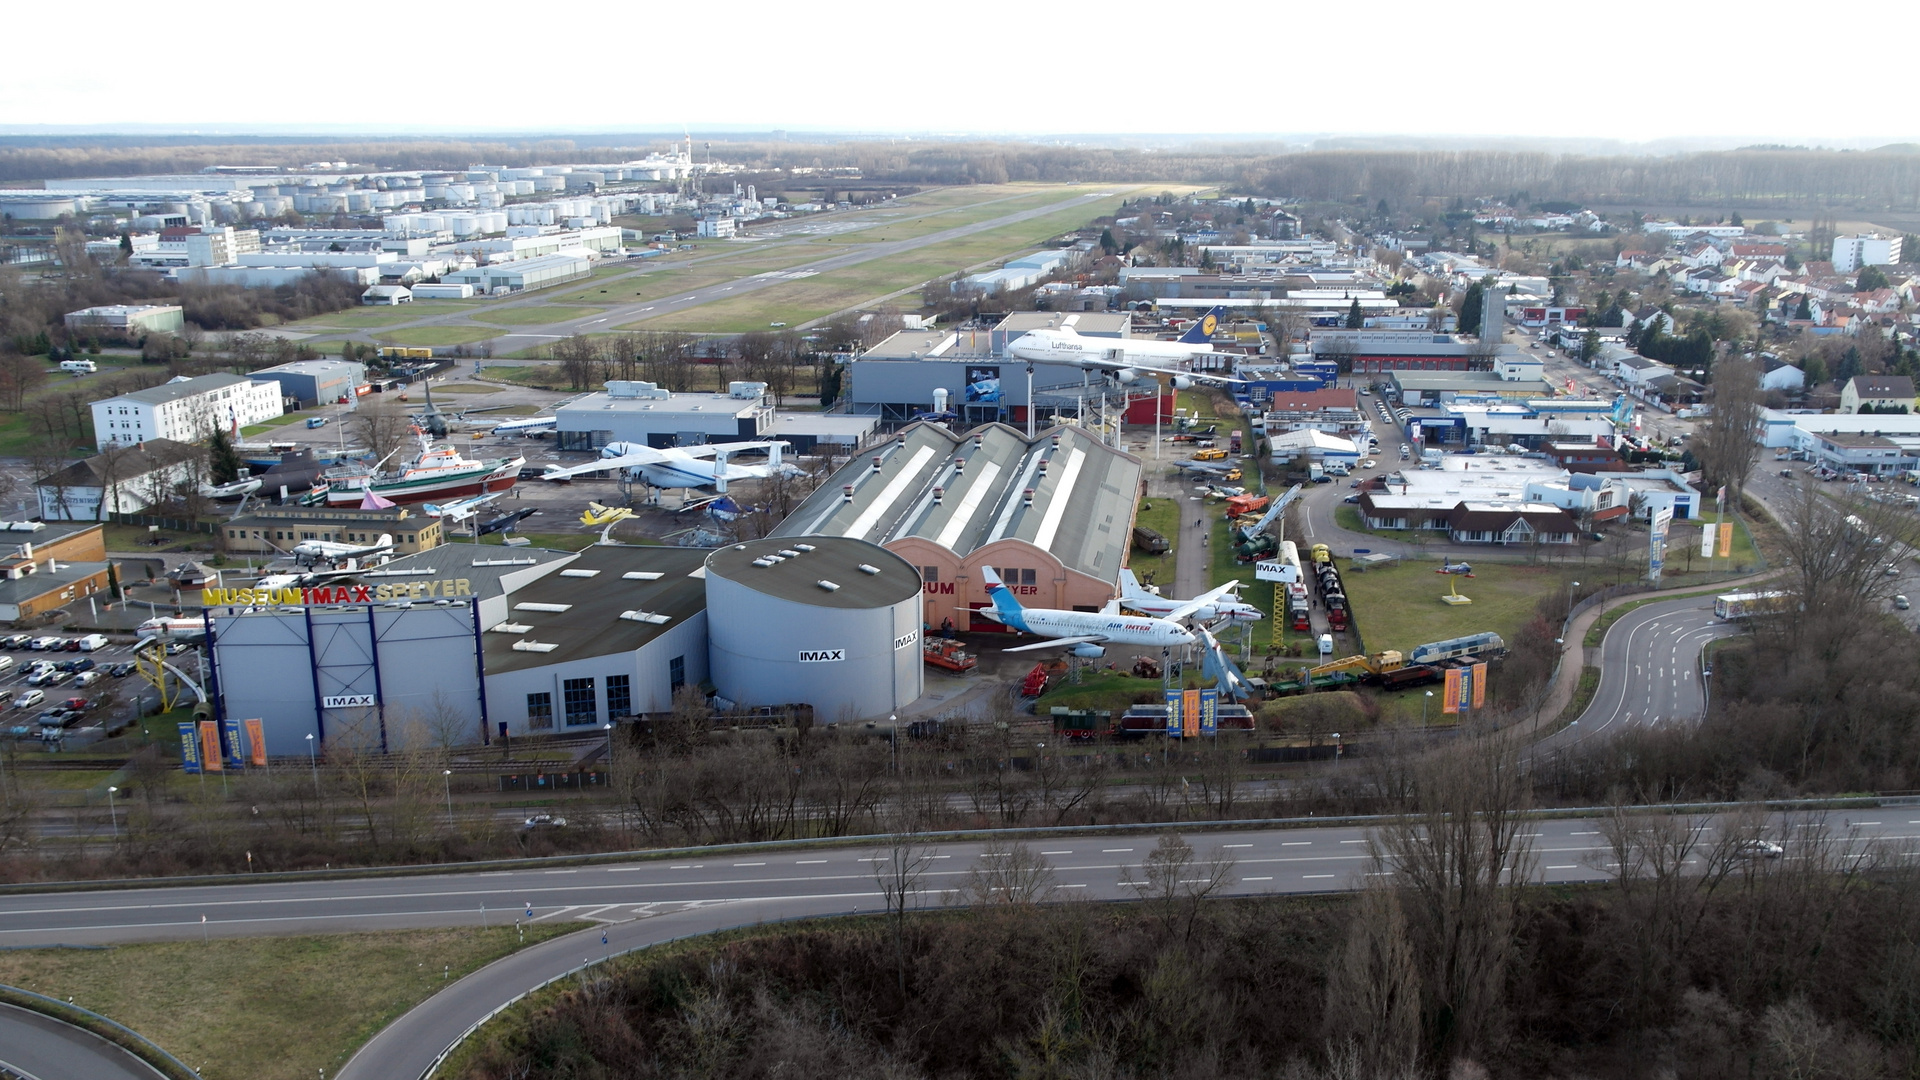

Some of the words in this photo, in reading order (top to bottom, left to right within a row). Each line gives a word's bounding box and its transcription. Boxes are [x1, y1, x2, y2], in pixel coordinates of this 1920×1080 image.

[1051, 341, 1082, 351] Lufthansa
[489, 472, 506, 480] SAR
[1256, 564, 1286, 574] IMAX
[202, 587, 302, 606] MUSEUM
[302, 584, 373, 605] IMAX
[376, 578, 471, 601] SPEYER
[895, 632, 917, 649] IMAX
[800, 651, 842, 661] IMAX
[327, 696, 370, 706] IMAX
